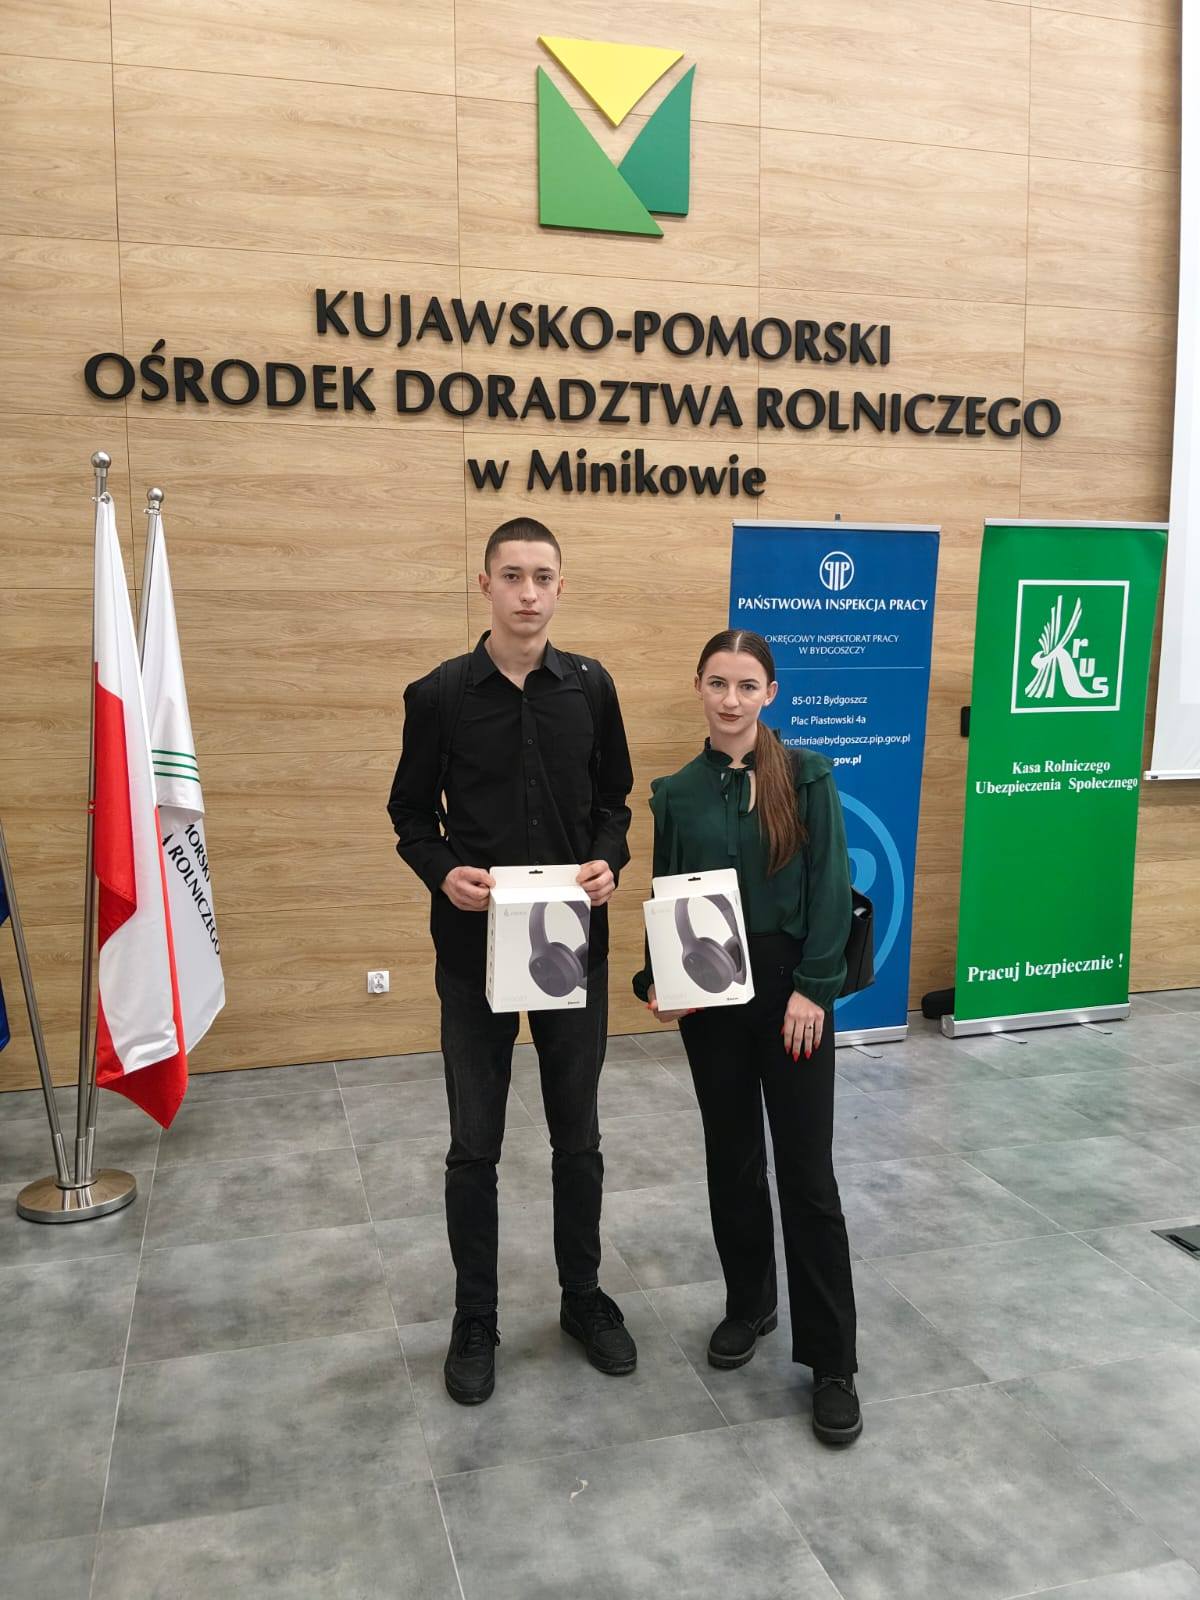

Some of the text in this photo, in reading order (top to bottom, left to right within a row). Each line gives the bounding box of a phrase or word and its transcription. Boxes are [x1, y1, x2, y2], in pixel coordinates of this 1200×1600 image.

[316, 288, 890, 365] KUJAWSKO-POMORSKI
[84, 339, 1061, 438] OŚRODEK DORADZTWA ROLNICZEGO
[467, 448, 767, 496] w Minikowie
[737, 594, 929, 613] PAŃSTWOWA INSPEKCJA PRACY
[764, 634, 900, 645] OKRĘGOWY INSPEKTORAT PRACY
[798, 646, 866, 656] W BYDGOSZCZY
[791, 695, 868, 707] 85-012 Bydgoszcz
[791, 714, 866, 726] Plac Piastowski 4a
[781, 734, 911, 747] ncelaria@bydgoszcz.pip.gov.pl
[1012, 759, 1111, 775] Kasa Rolniczego
[975, 776, 1138, 796] Ubezpieczenia Społecznego
[167, 844, 220, 955] ROLNICZEGO
[967, 962, 1020, 982] Pracuj
[1025, 954, 1114, 978] bezpiecznie
